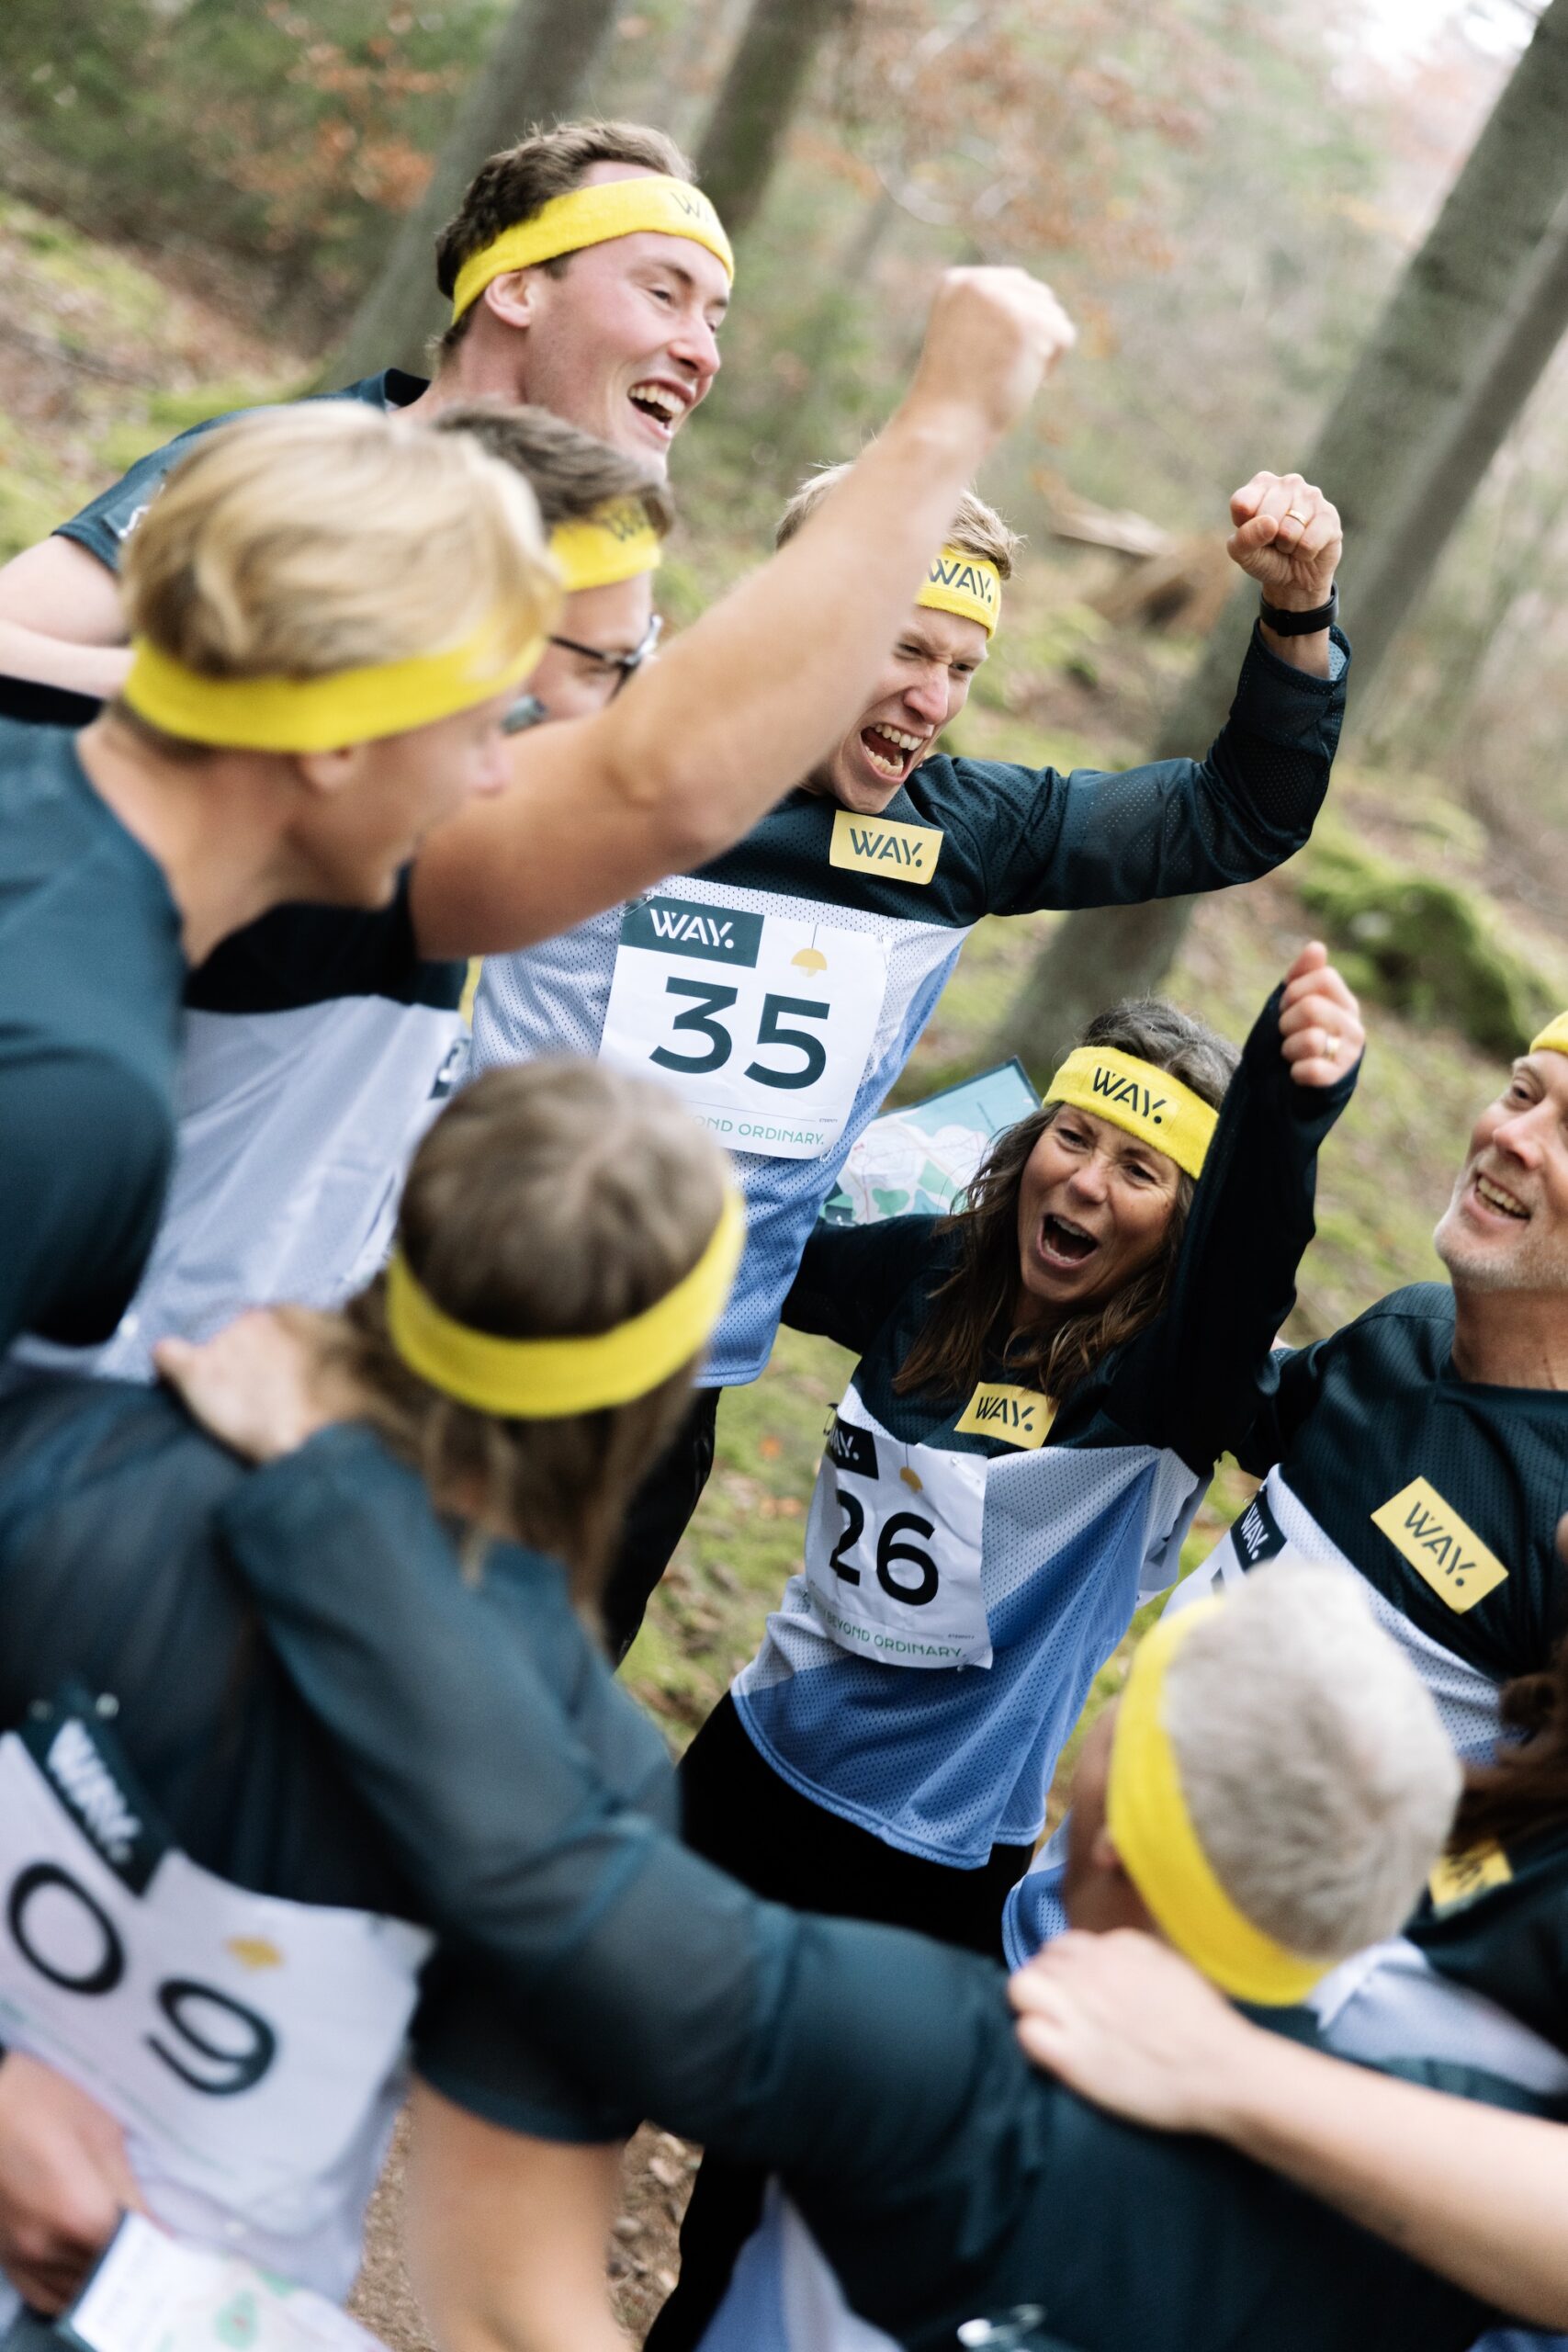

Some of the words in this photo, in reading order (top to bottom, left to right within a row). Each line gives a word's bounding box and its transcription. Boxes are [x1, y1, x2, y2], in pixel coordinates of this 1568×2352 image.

[850, 828, 923, 868] WAY.
[649, 908, 735, 950] WAY.
[649, 976, 830, 1091] 35
[1091, 1066, 1168, 1125] WAY.
[739, 1123, 824, 1146] ORDINARY.
[976, 1396, 1035, 1432] WAY.
[829, 1488, 939, 1606] 26
[1240, 1501, 1269, 1560] WAY.
[1403, 1500, 1478, 1589] WAY.
[6, 1861, 278, 2098] 09
